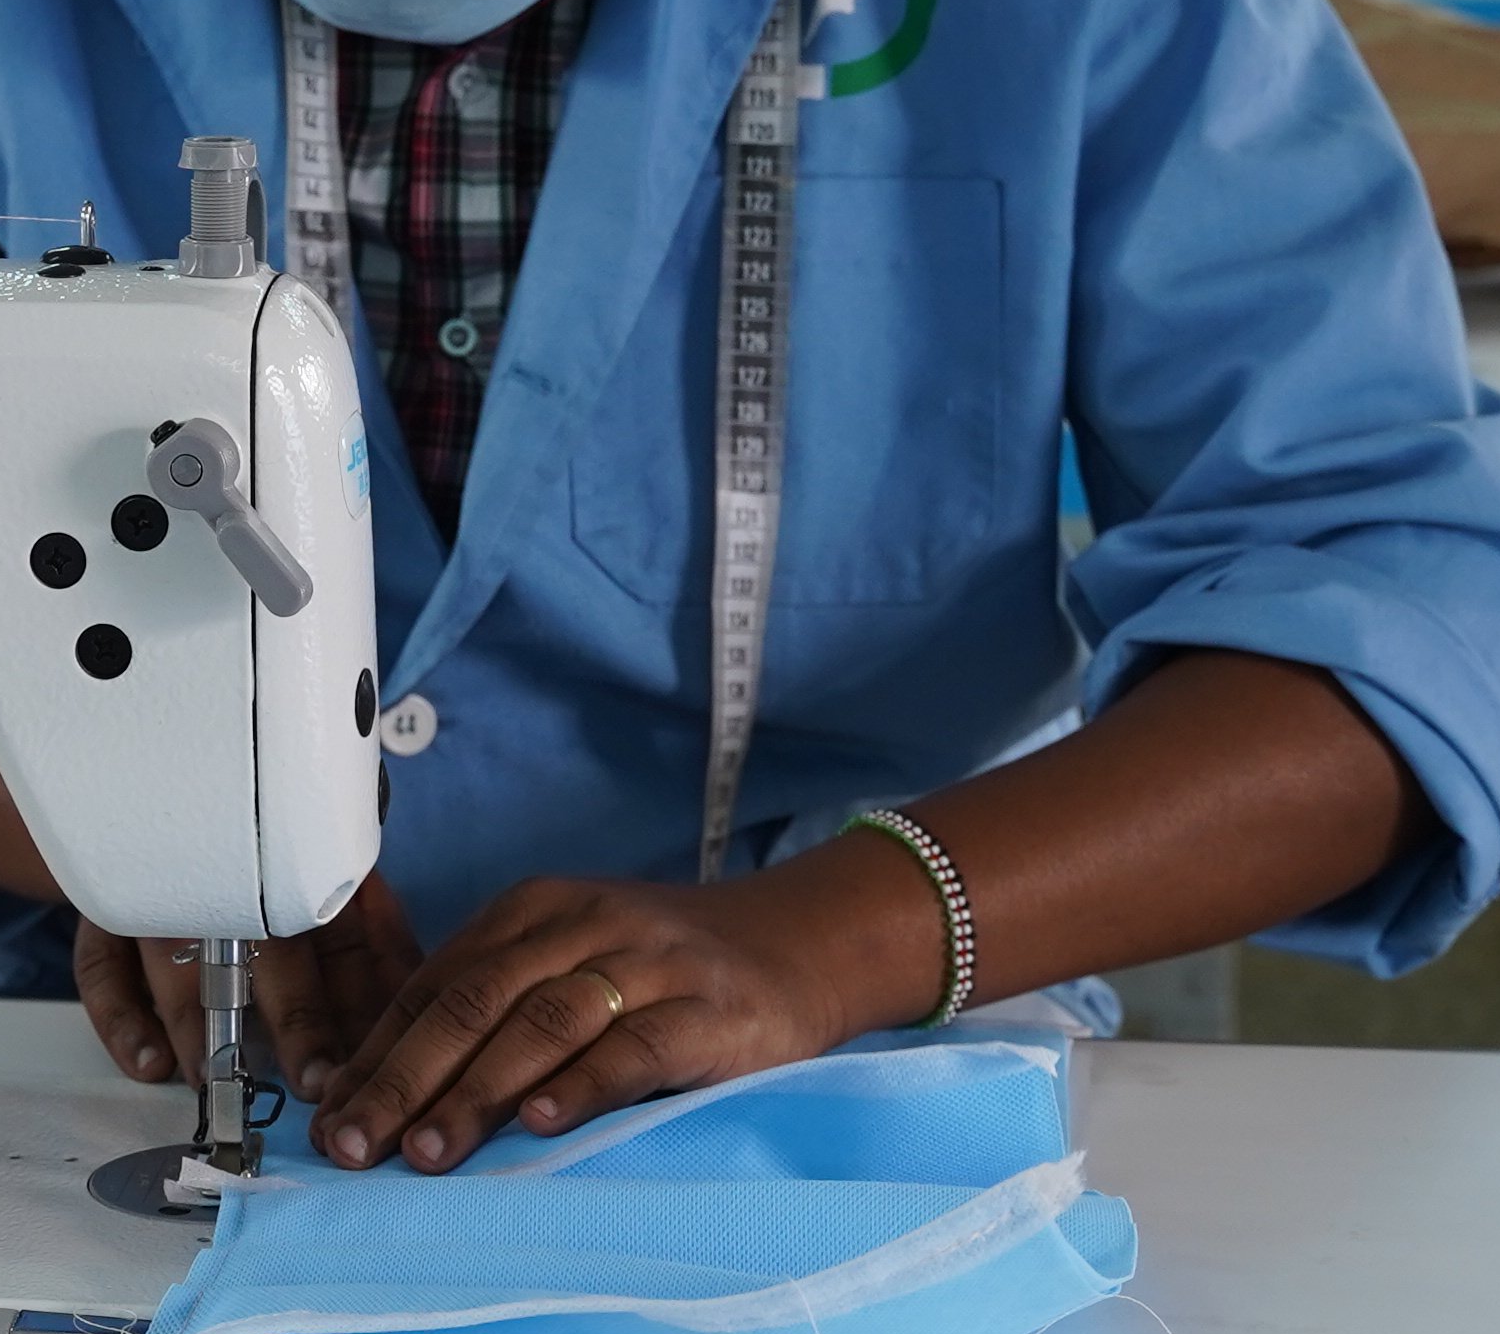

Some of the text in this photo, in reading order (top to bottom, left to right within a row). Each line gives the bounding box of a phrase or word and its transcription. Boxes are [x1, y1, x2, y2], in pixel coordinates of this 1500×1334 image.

[743, 190, 774, 212] 122
[743, 226, 773, 249] 123
[741, 260, 771, 282] 124
[740, 295, 770, 318] 125
[738, 331, 769, 354] 126
[737, 366, 767, 388] 127
